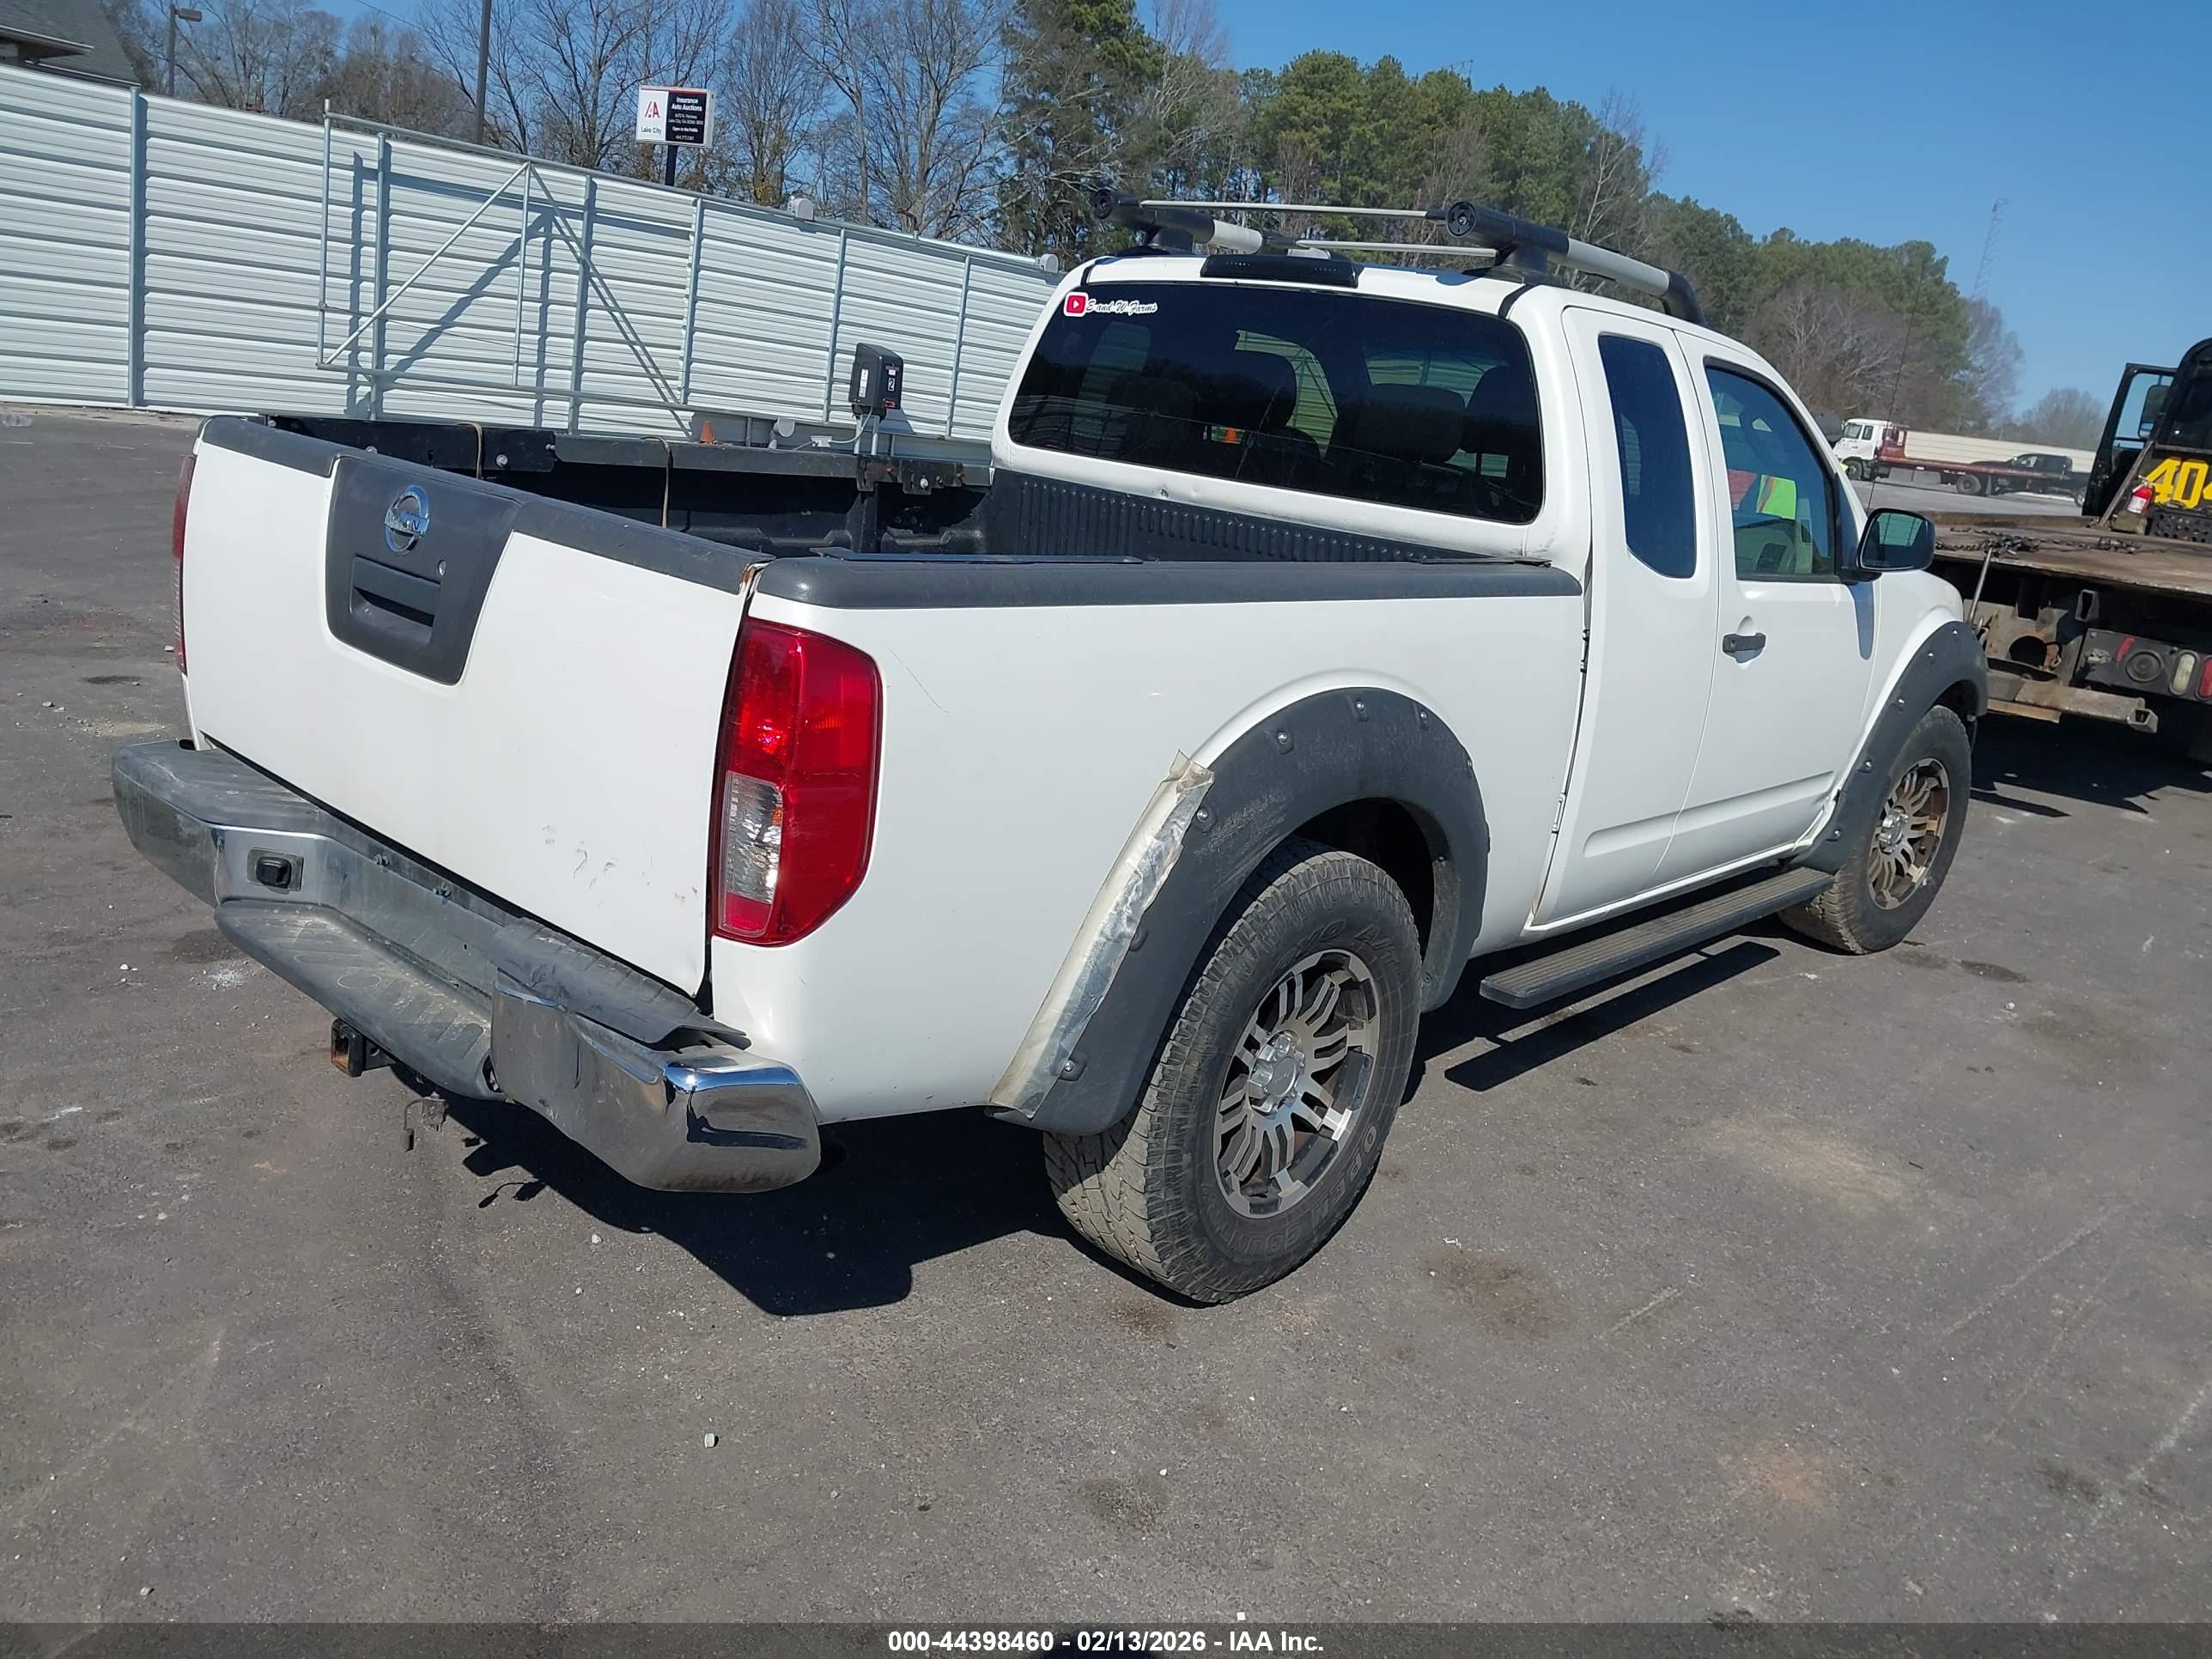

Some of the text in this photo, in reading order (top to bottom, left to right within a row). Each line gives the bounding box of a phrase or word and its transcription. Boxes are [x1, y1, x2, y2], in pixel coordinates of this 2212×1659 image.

[1085, 300, 1157, 314] E and W Farms
[889, 379, 894, 390] 2
[2146, 457, 2212, 508] 40
[1310, 1125, 1378, 1228] OPEN
